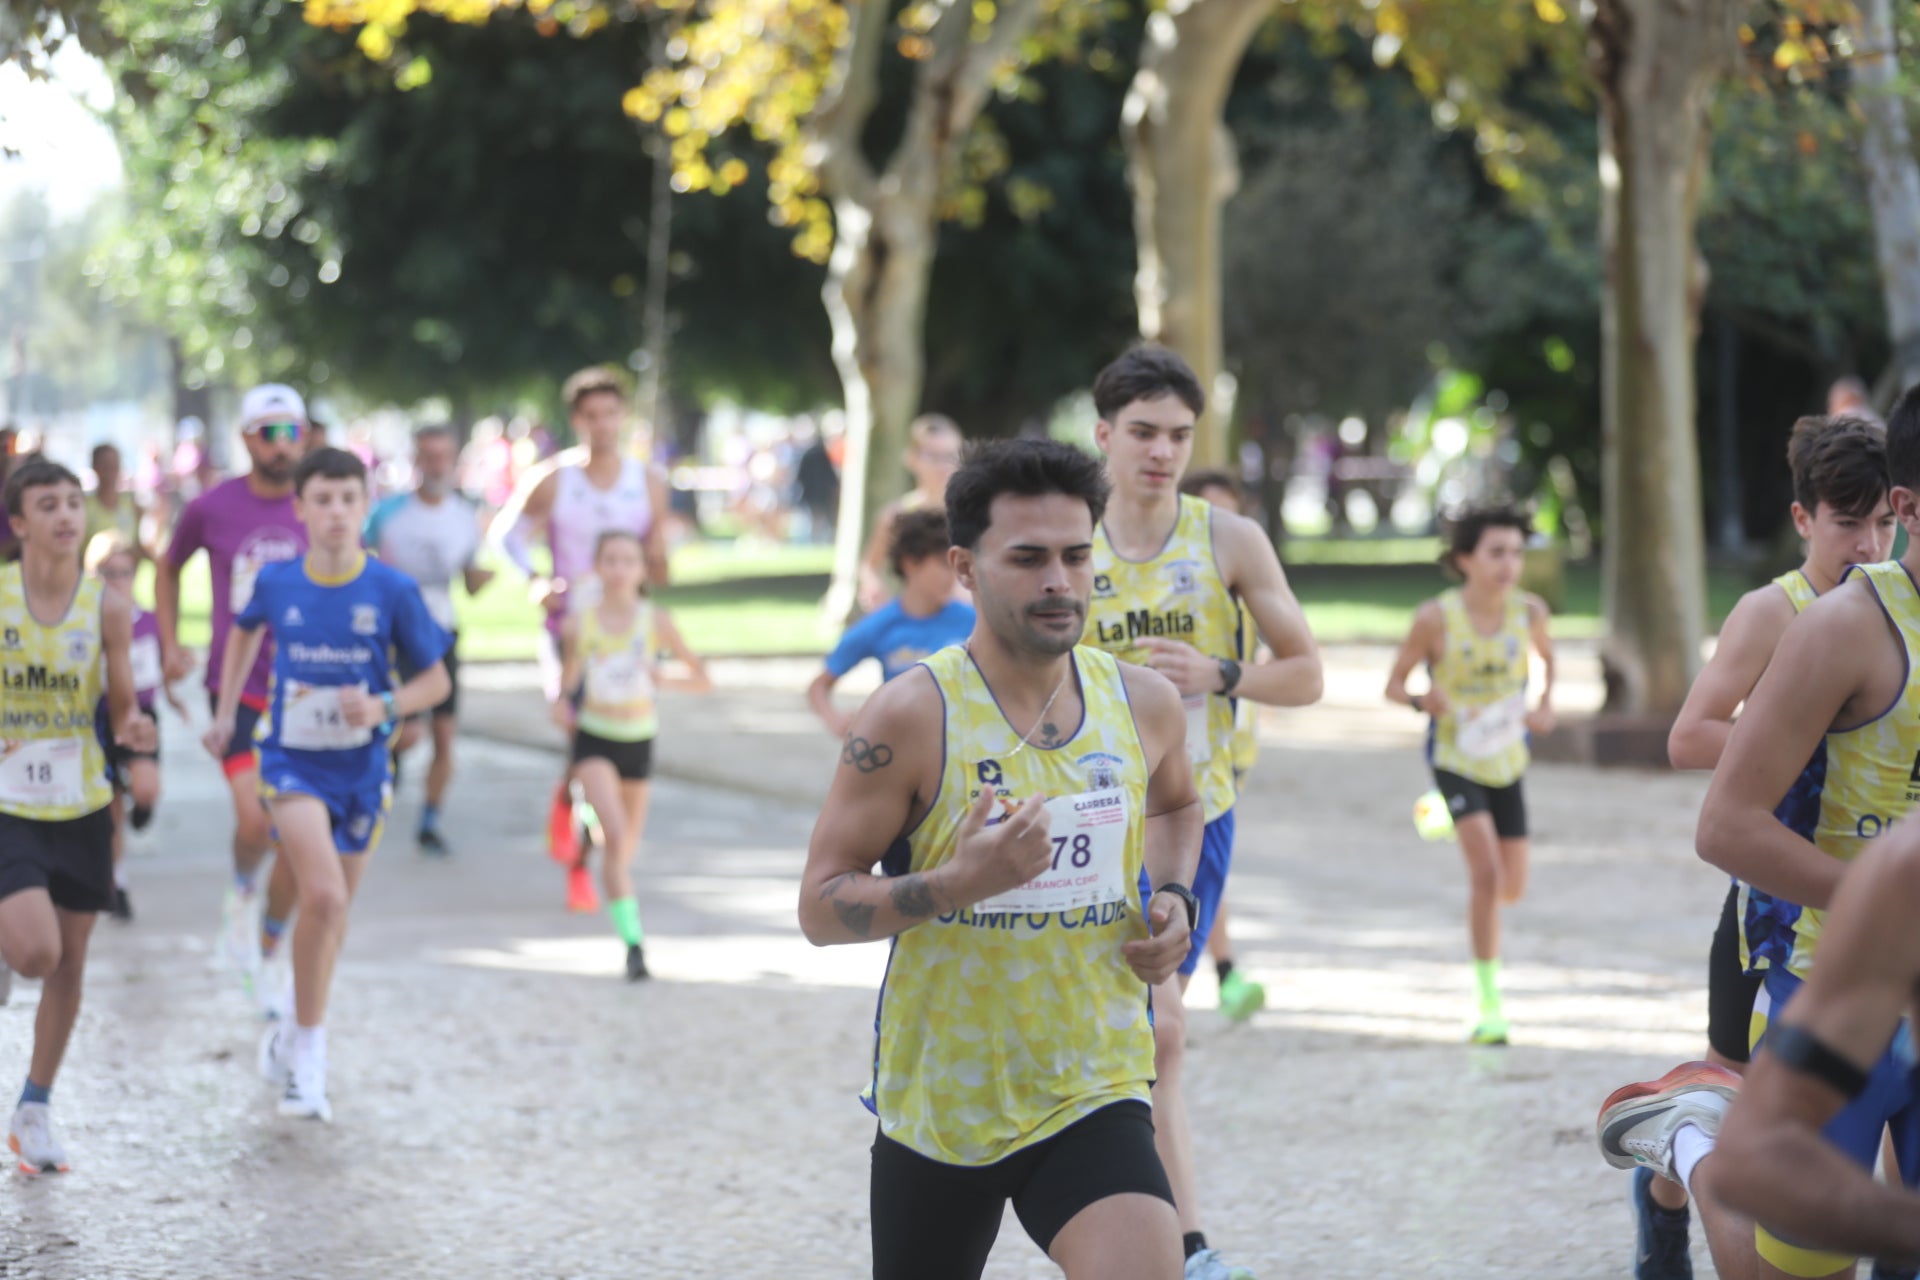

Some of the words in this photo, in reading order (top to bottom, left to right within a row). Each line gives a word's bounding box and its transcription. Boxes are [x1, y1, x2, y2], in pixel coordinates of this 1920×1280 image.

[26, 763, 53, 783] 18
[1074, 796, 1122, 812] CARRERA
[1051, 834, 1092, 871] 78
